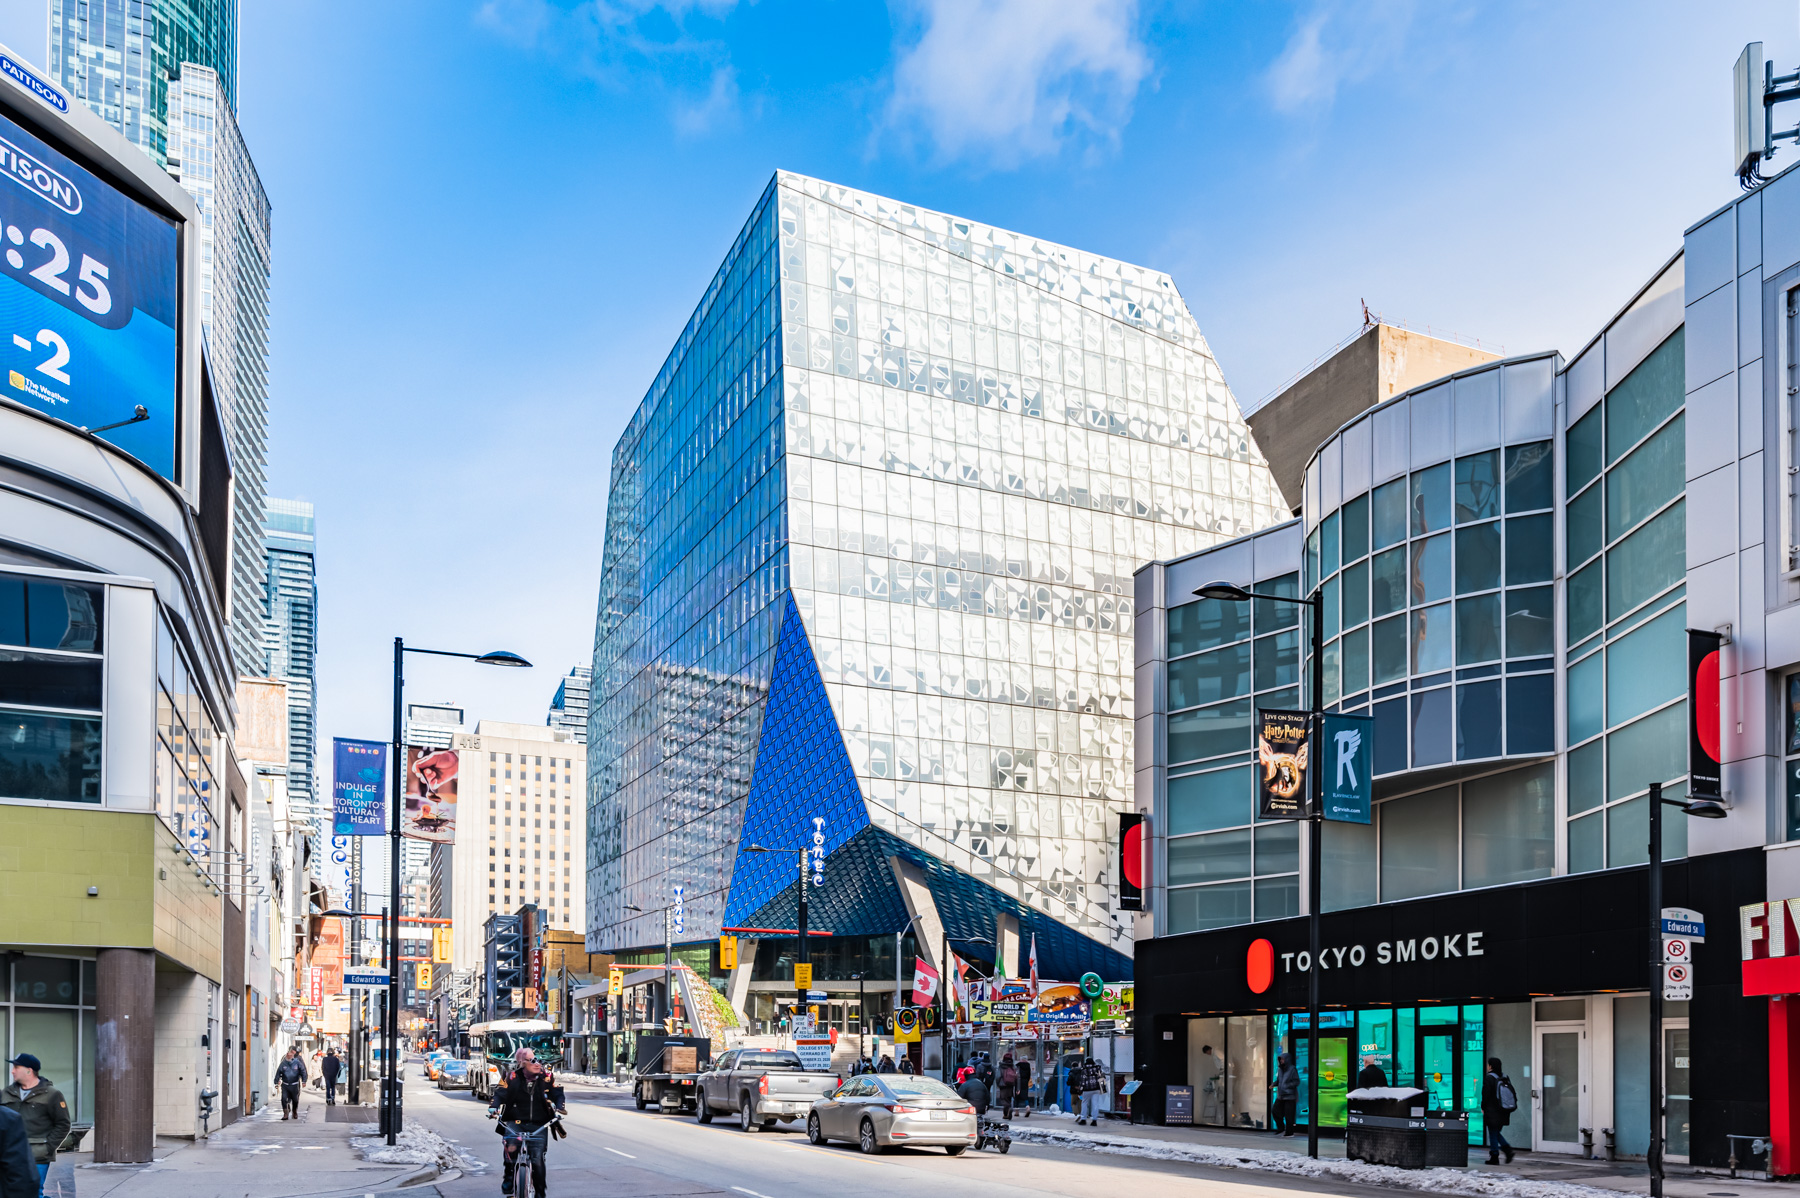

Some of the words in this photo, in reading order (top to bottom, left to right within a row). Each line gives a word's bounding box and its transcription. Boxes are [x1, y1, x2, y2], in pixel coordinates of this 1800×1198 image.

[2, 59, 64, 109] PATTISON
[0, 217, 112, 315] :25
[13, 328, 70, 386] -2
[25, 385, 56, 405] Network
[26, 378, 39, 390] The
[40, 384, 70, 404] Weather
[1264, 724, 1284, 739] Harry
[1284, 724, 1305, 740] Potter
[460, 736, 480, 749] 415
[336, 782, 377, 793] INDULGE
[333, 806, 378, 816] CULTURAL
[334, 798, 385, 810] TORONTO'S
[350, 816, 380, 824] HEART
[1668, 921, 1691, 933] Edward
[1693, 926, 1698, 934] St
[1281, 945, 1366, 973] TOKYO
[1376, 932, 1484, 965] SMOKE
[886, 1016, 894, 1030] G
[1362, 1043, 1378, 1052] open
